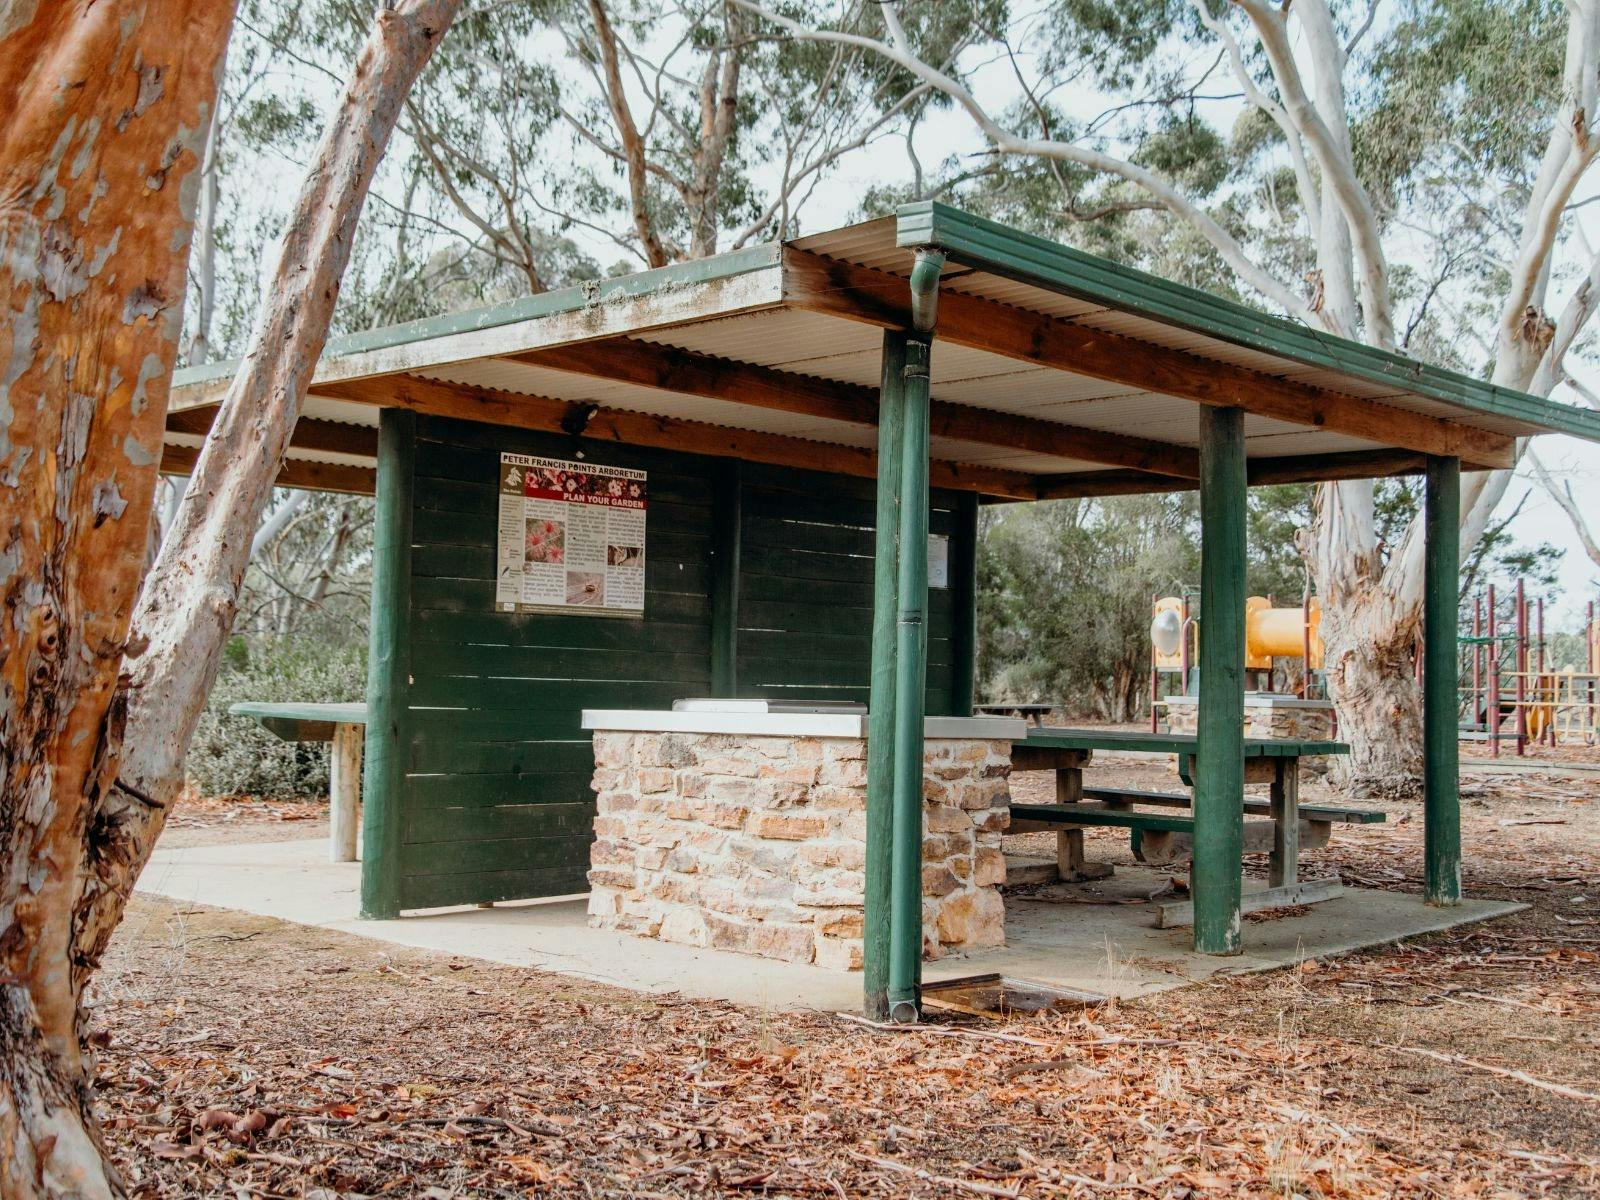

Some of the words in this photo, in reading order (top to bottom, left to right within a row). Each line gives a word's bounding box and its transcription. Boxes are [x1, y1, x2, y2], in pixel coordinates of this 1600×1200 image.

[503, 455, 529, 465] PETER
[532, 459, 566, 470] FRANCIS
[568, 464, 597, 474] POINTS
[598, 468, 645, 480] ARBORETUM
[564, 492, 585, 502] PLAN
[588, 496, 610, 505] YOUR
[612, 498, 644, 509] GARDEN
